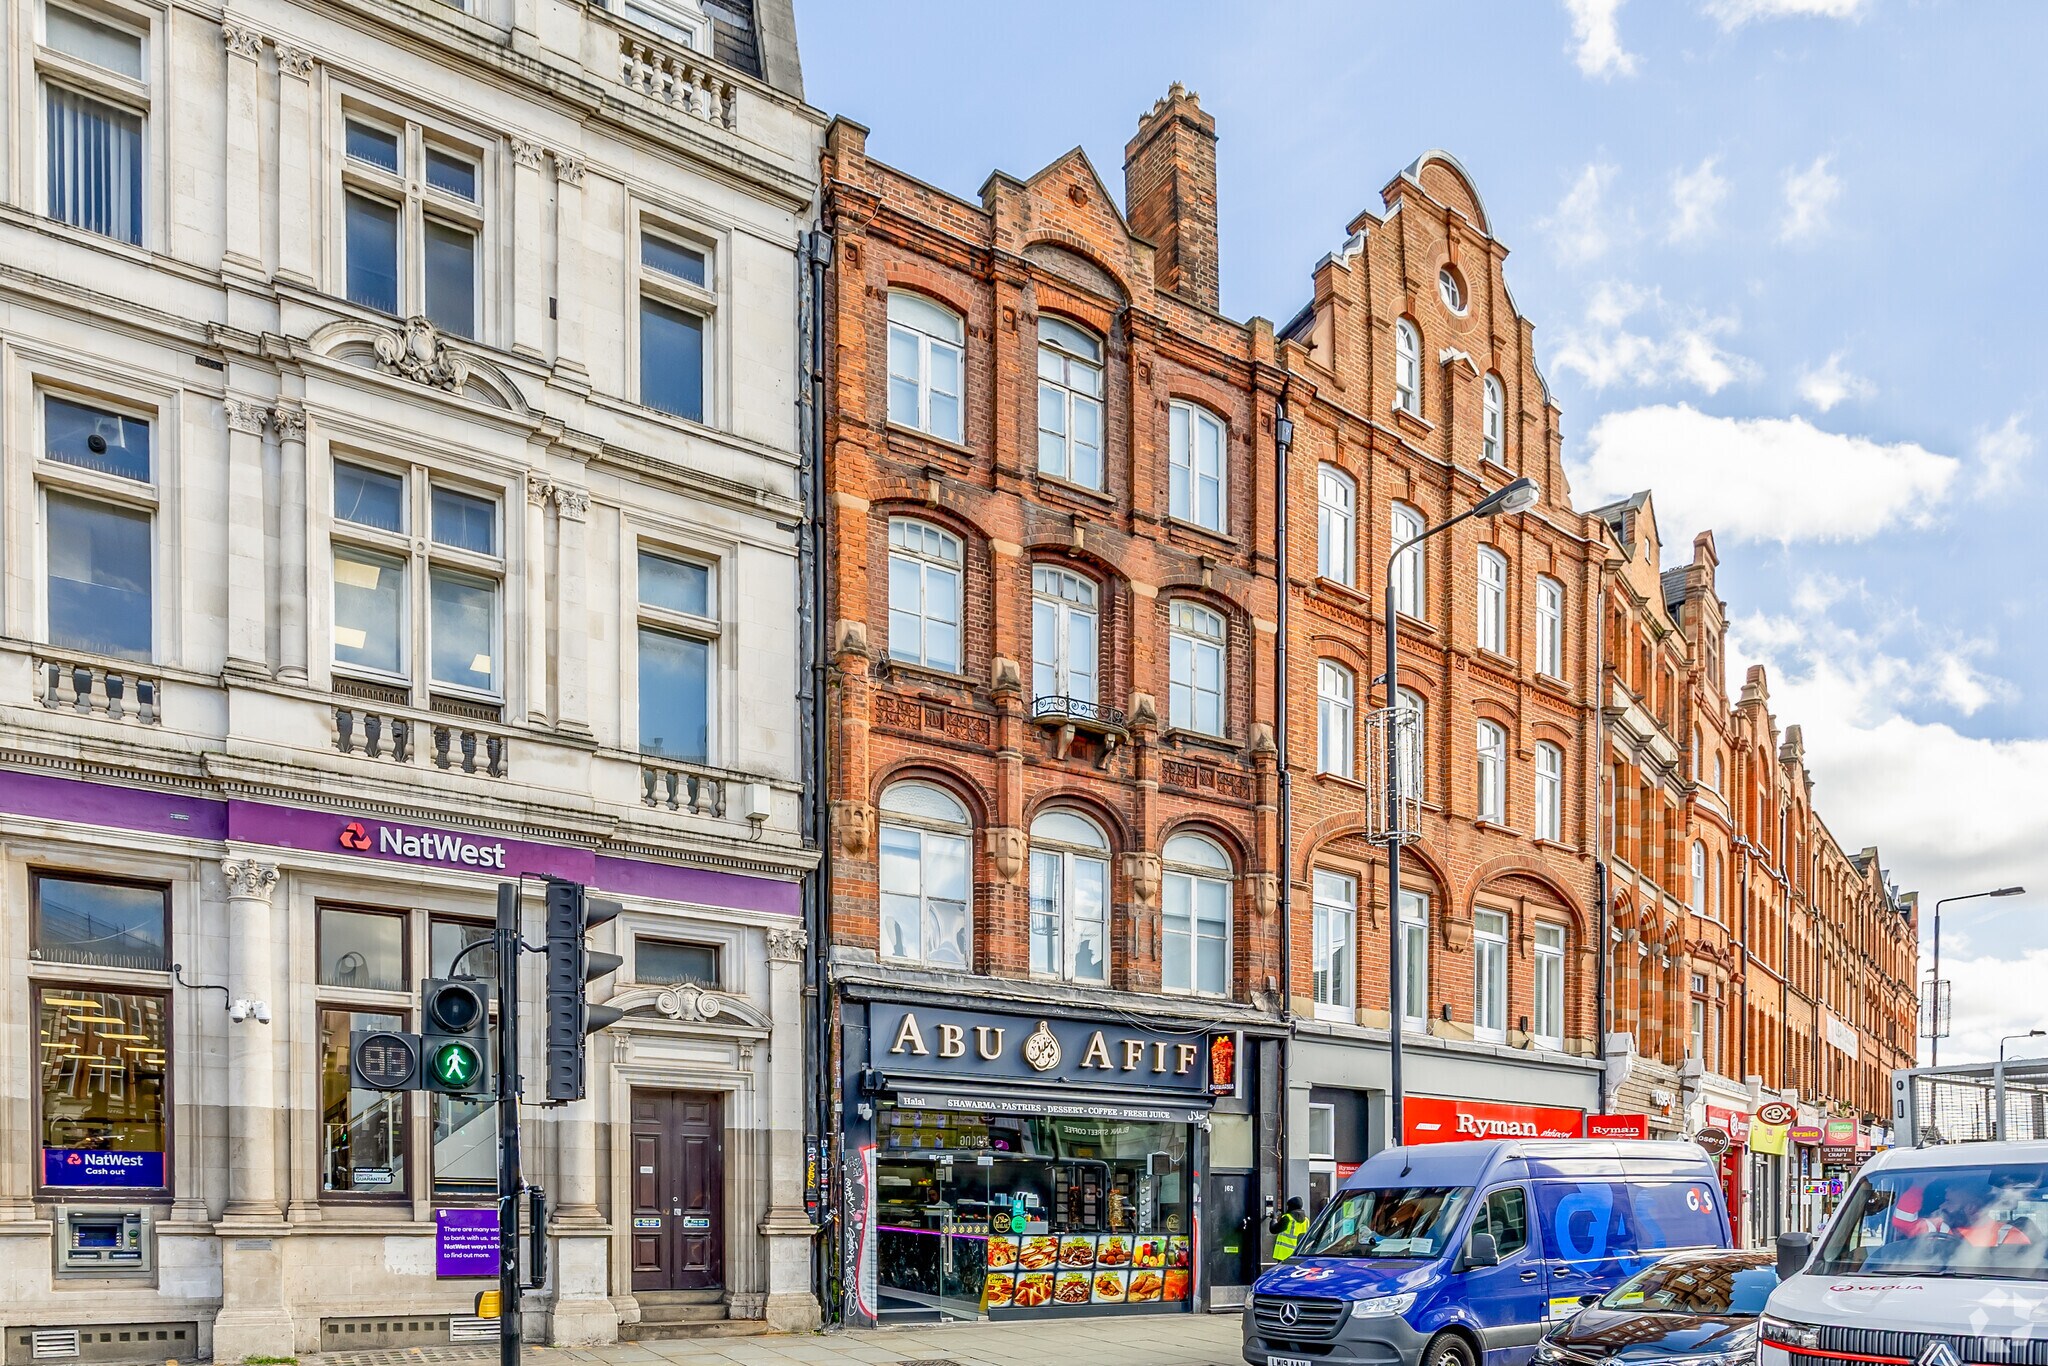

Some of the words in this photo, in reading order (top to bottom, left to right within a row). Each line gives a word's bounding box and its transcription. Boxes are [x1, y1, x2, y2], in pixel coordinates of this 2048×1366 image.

[380, 826, 506, 869] NatWest
[891, 1013, 1006, 1061] ABU
[1080, 1030, 1198, 1074] AFIF
[903, 1097, 925, 1106] Halal
[947, 1099, 996, 1110] SHAWARMA
[1001, 1102, 1041, 1112] PASTRIES
[1047, 1105, 1083, 1114] DESSERT
[1088, 1106, 1118, 1116] COFFEE
[1123, 1109, 1148, 1118] FRESH
[1149, 1110, 1170, 1119] JUICE
[1456, 1113, 1538, 1138] Ryman
[1592, 1126, 1640, 1135] Ryman
[1792, 1130, 1819, 1138] traid
[84, 1153, 143, 1166] NatWest
[85, 1167, 108, 1175] Cash
